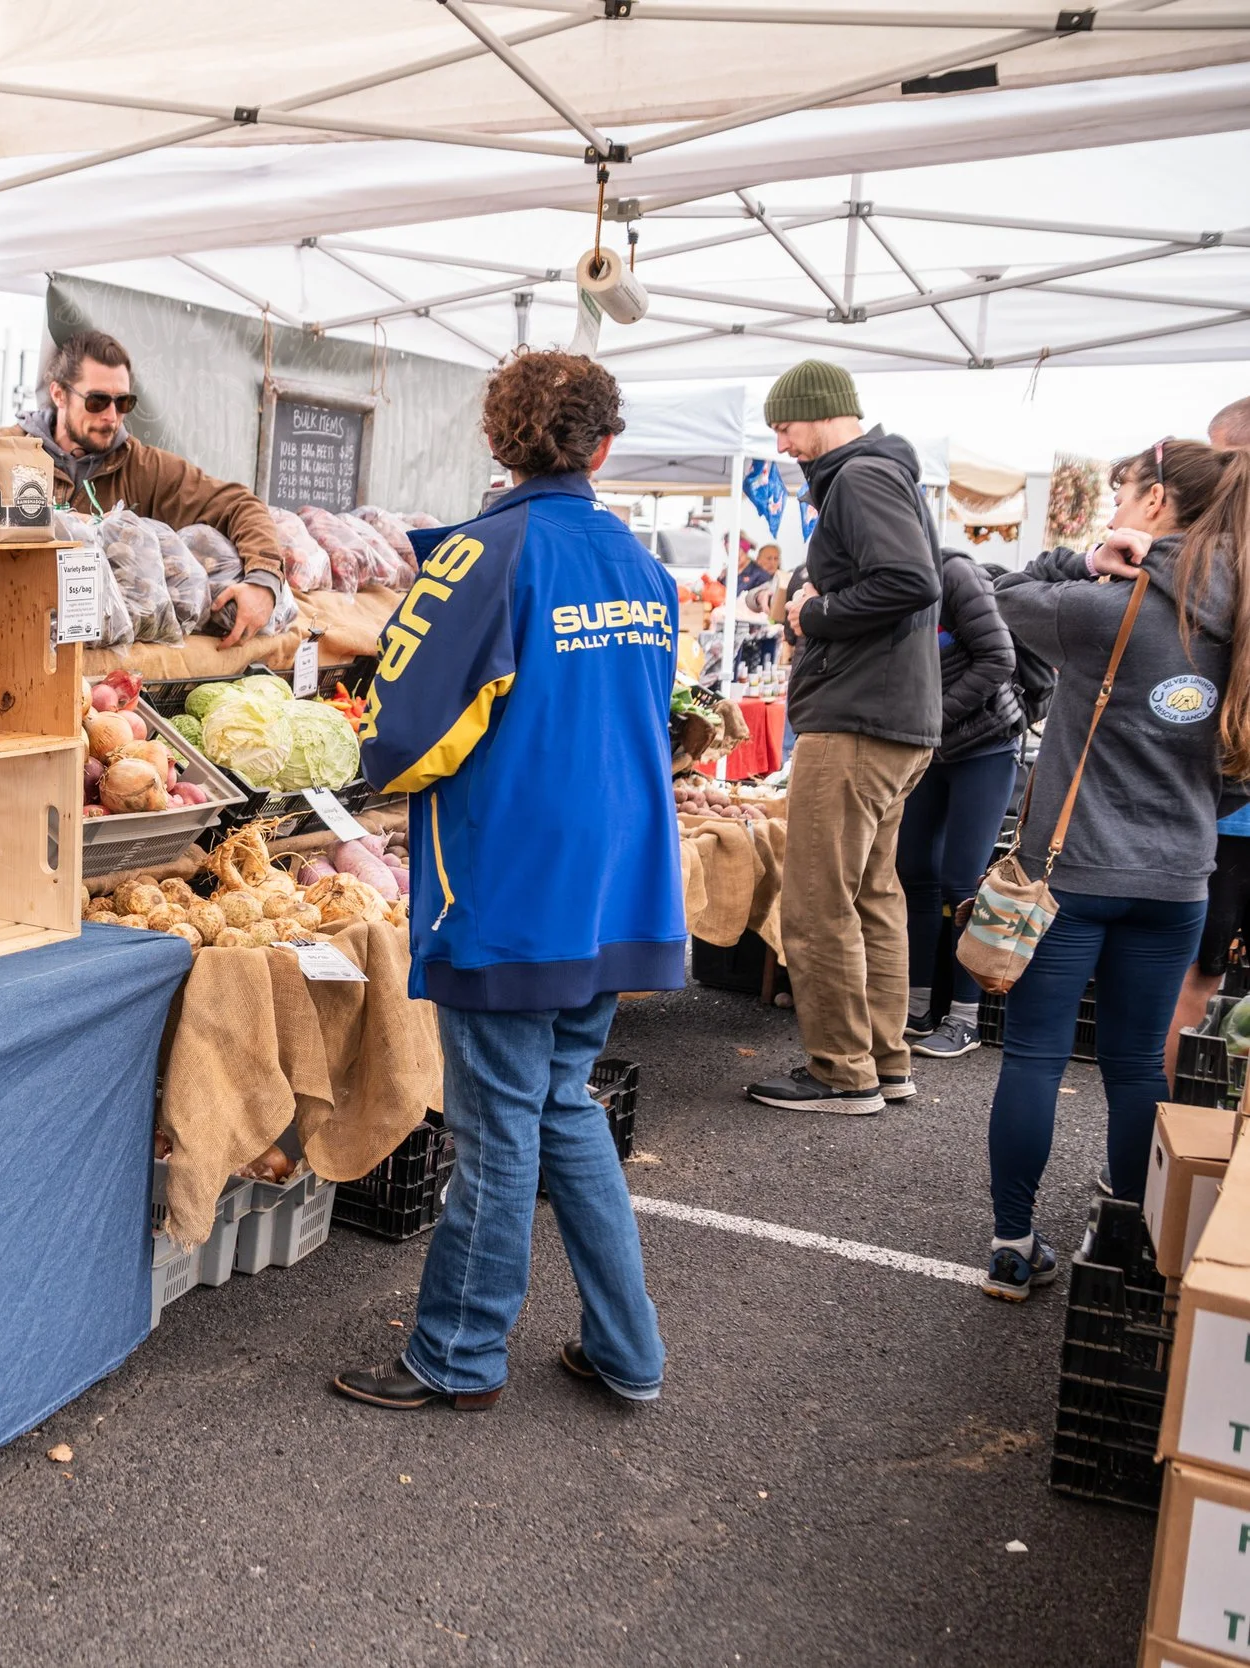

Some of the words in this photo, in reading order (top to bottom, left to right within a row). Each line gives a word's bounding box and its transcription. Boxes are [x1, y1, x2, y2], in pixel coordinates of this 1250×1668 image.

[293, 409, 317, 429] BULK
[319, 414, 345, 437] ITEMS
[64, 566, 81, 574] Variety
[69, 585, 92, 594] $15/bag
[555, 633, 611, 653] RALLY
[1162, 676, 1190, 690] SILVER
[1190, 676, 1217, 694] LININGS
[1153, 704, 1179, 721] RESCUE
[1180, 709, 1208, 722] RANCH
